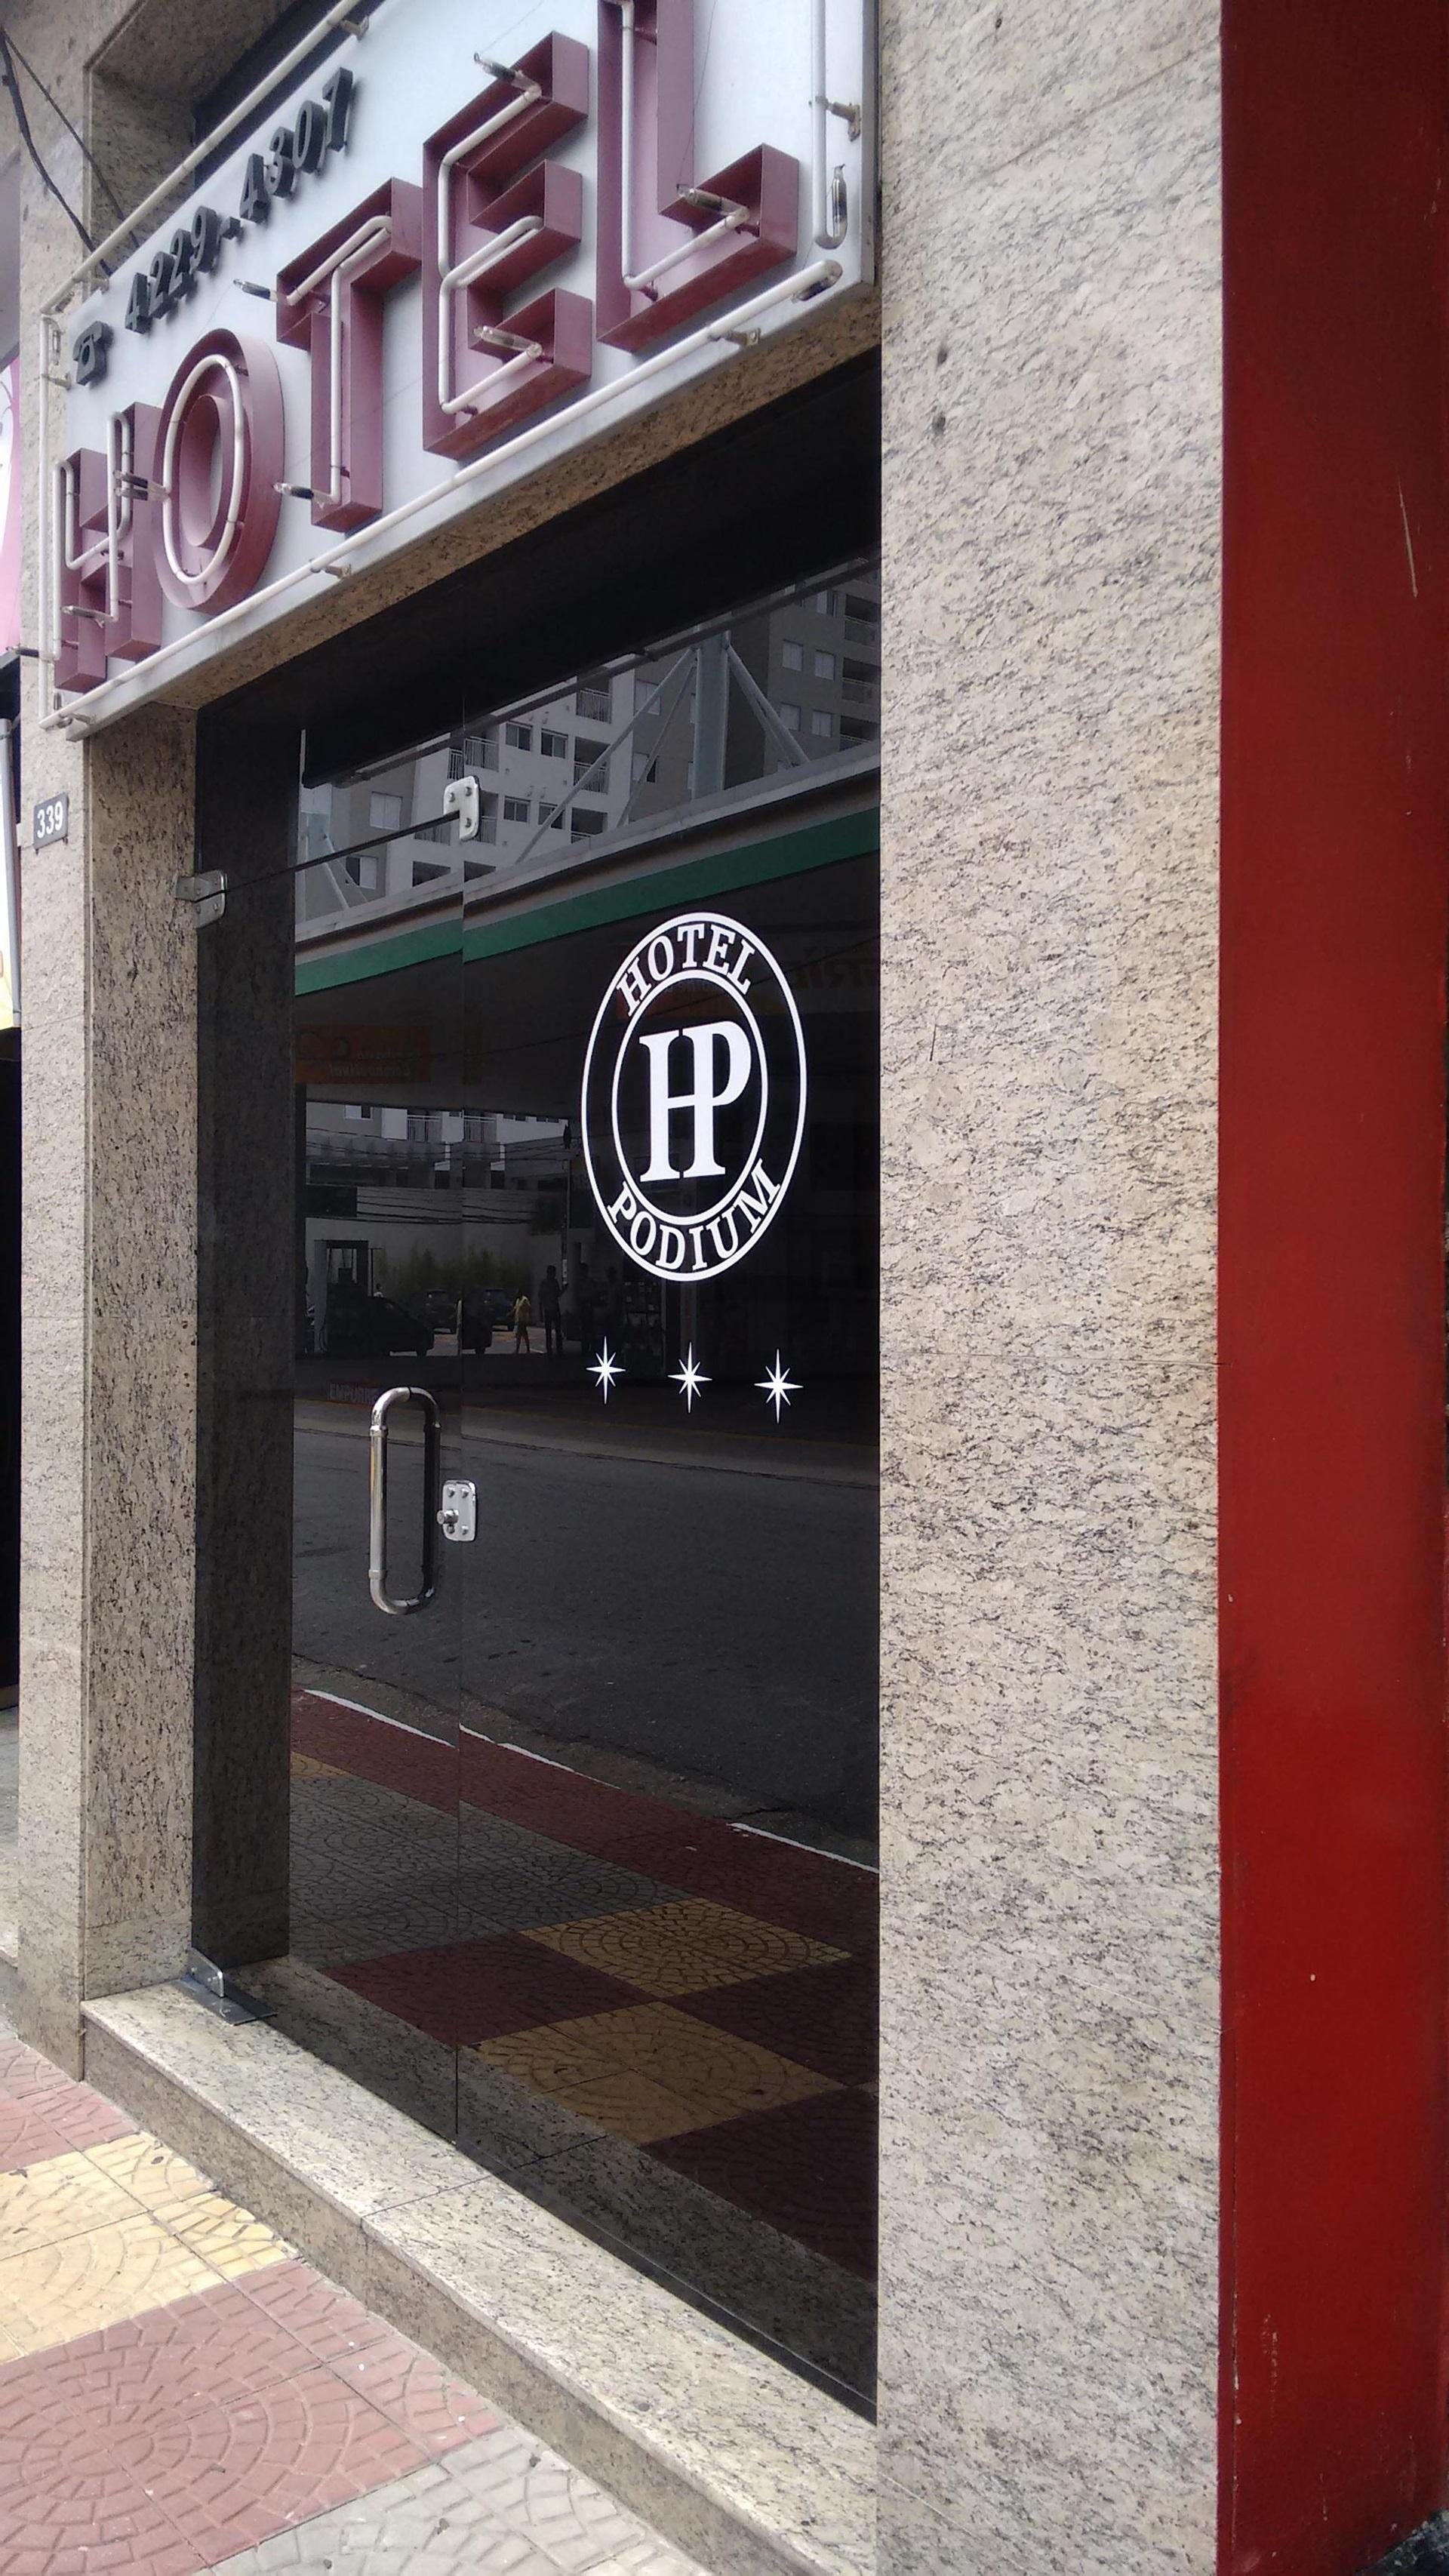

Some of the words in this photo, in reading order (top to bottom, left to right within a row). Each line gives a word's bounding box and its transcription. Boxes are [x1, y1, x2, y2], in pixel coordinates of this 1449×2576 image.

[53, 0, 800, 693] HOTEL
[37, 801, 63, 839] 339
[616, 923, 755, 1017] HOTEL
[638, 1020, 752, 1183] HP
[607, 1158, 780, 1271] PODIUM
